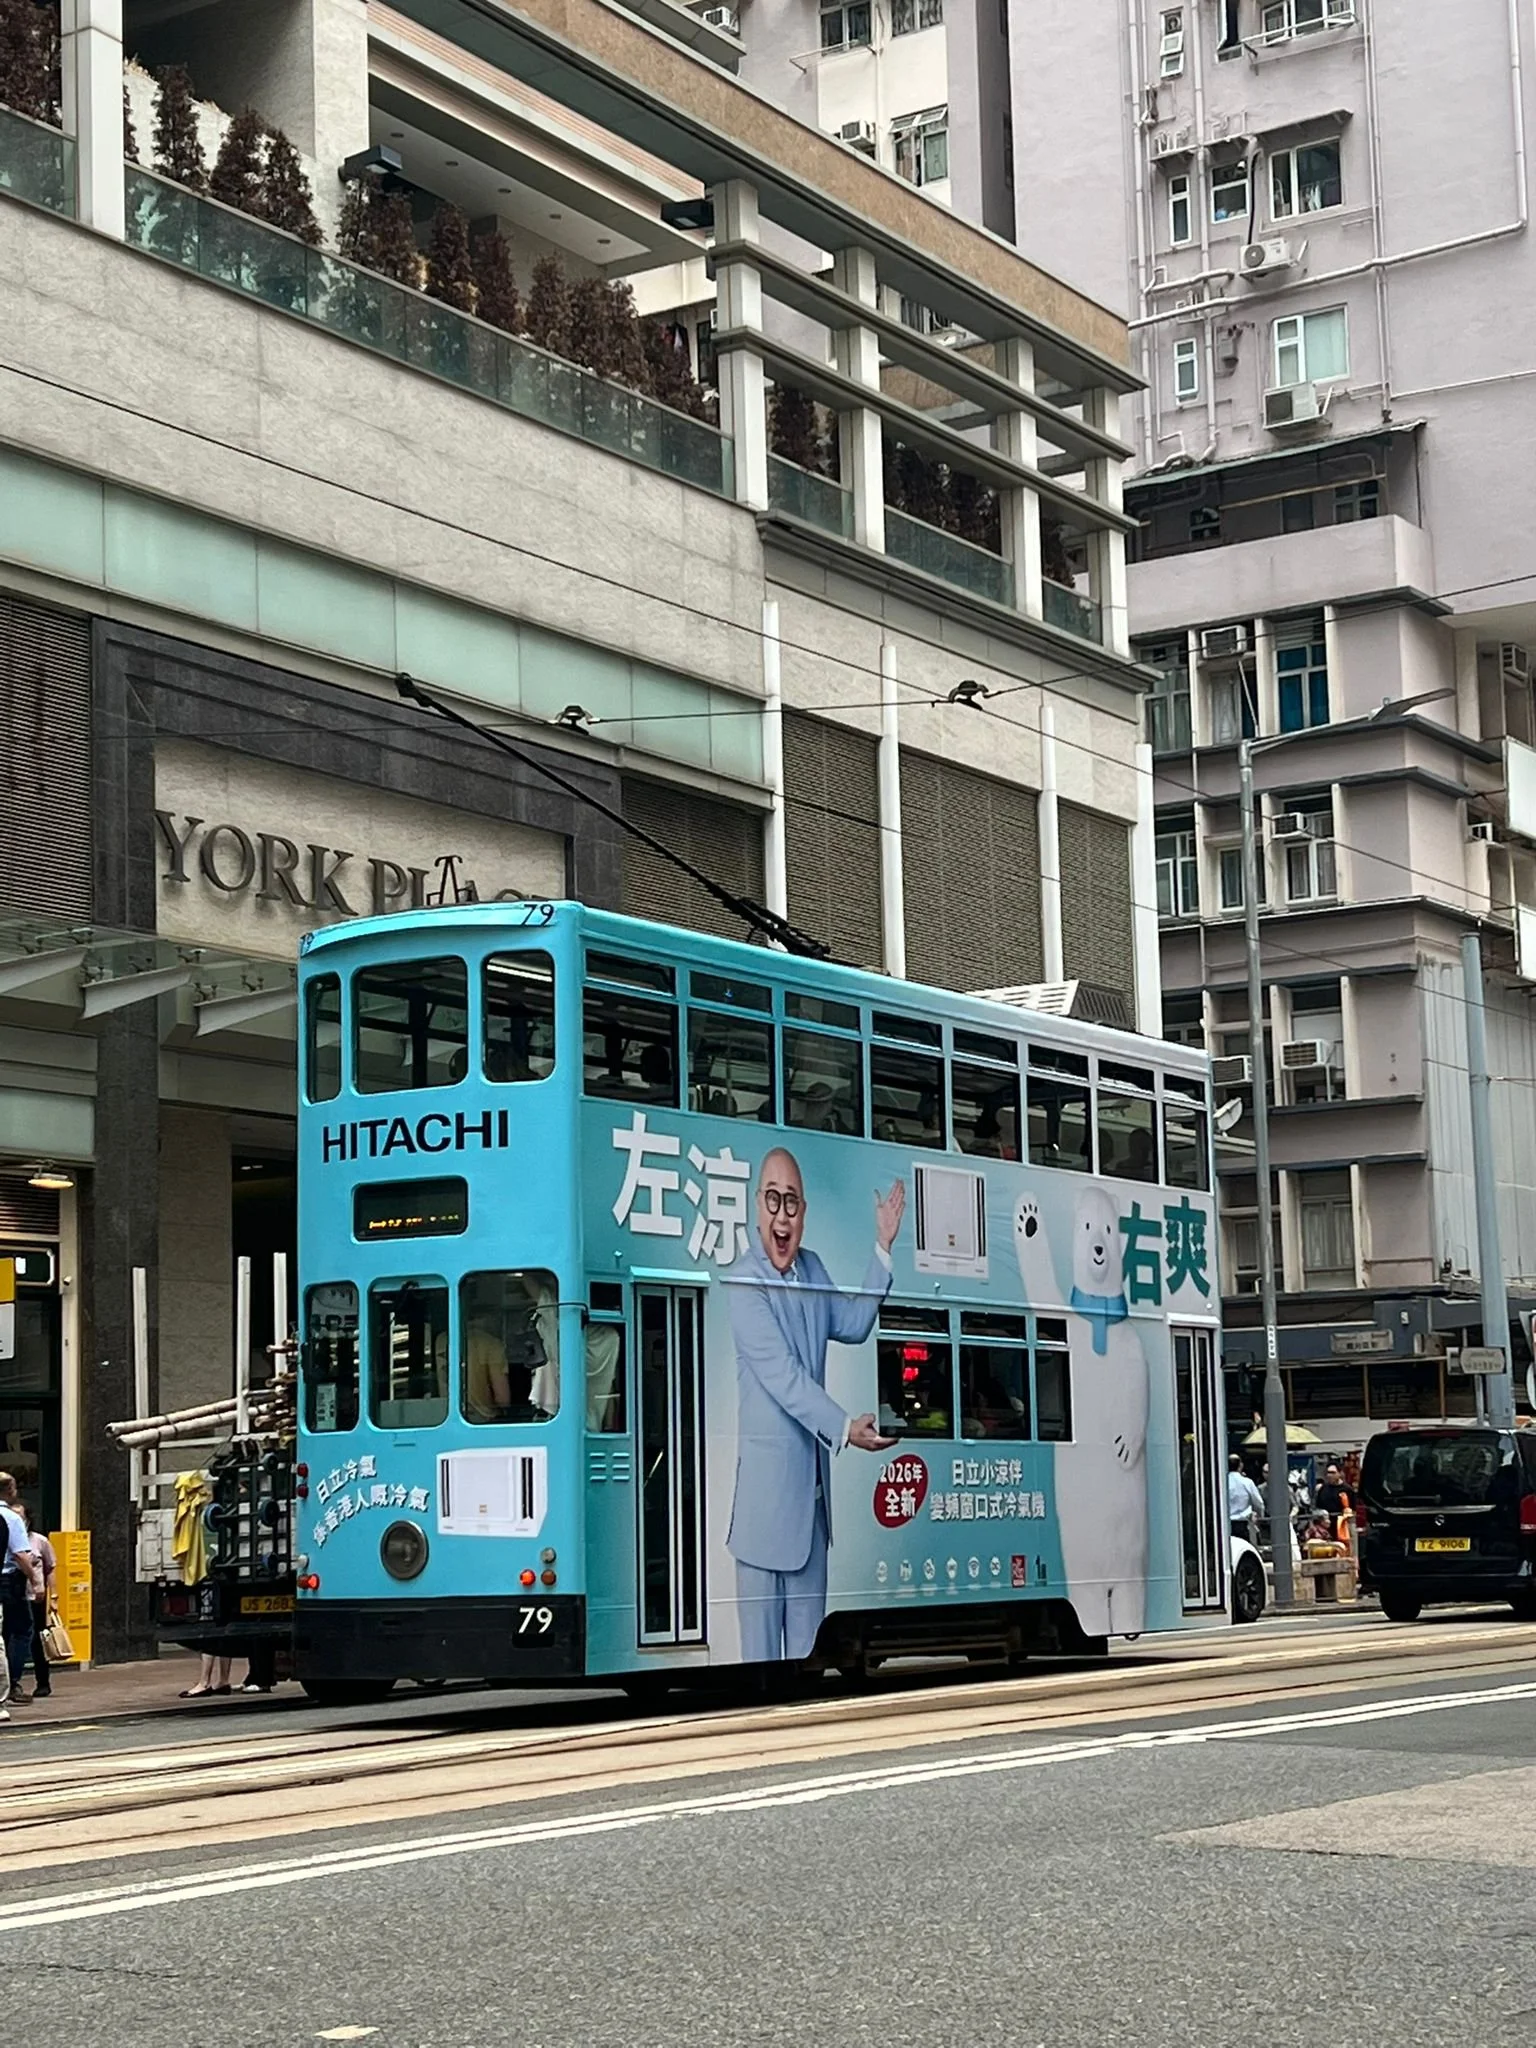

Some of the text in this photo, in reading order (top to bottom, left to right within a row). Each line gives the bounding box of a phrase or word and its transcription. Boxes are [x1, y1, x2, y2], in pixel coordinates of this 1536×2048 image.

[154, 809, 359, 916] YORK
[521, 903, 555, 927] 79
[322, 1109, 509, 1163] HITACHI
[612, 1110, 751, 1267] 左涼
[1118, 1195, 1211, 1307] 右爽
[315, 1454, 378, 1504] 日立冷氣
[879, 1462, 924, 1484] 2026年
[952, 1458, 1023, 1487] 日立小涼伴
[884, 1486, 917, 1517] 全新
[1420, 1539, 1434, 1550] TZ
[518, 1606, 553, 1634] 79
